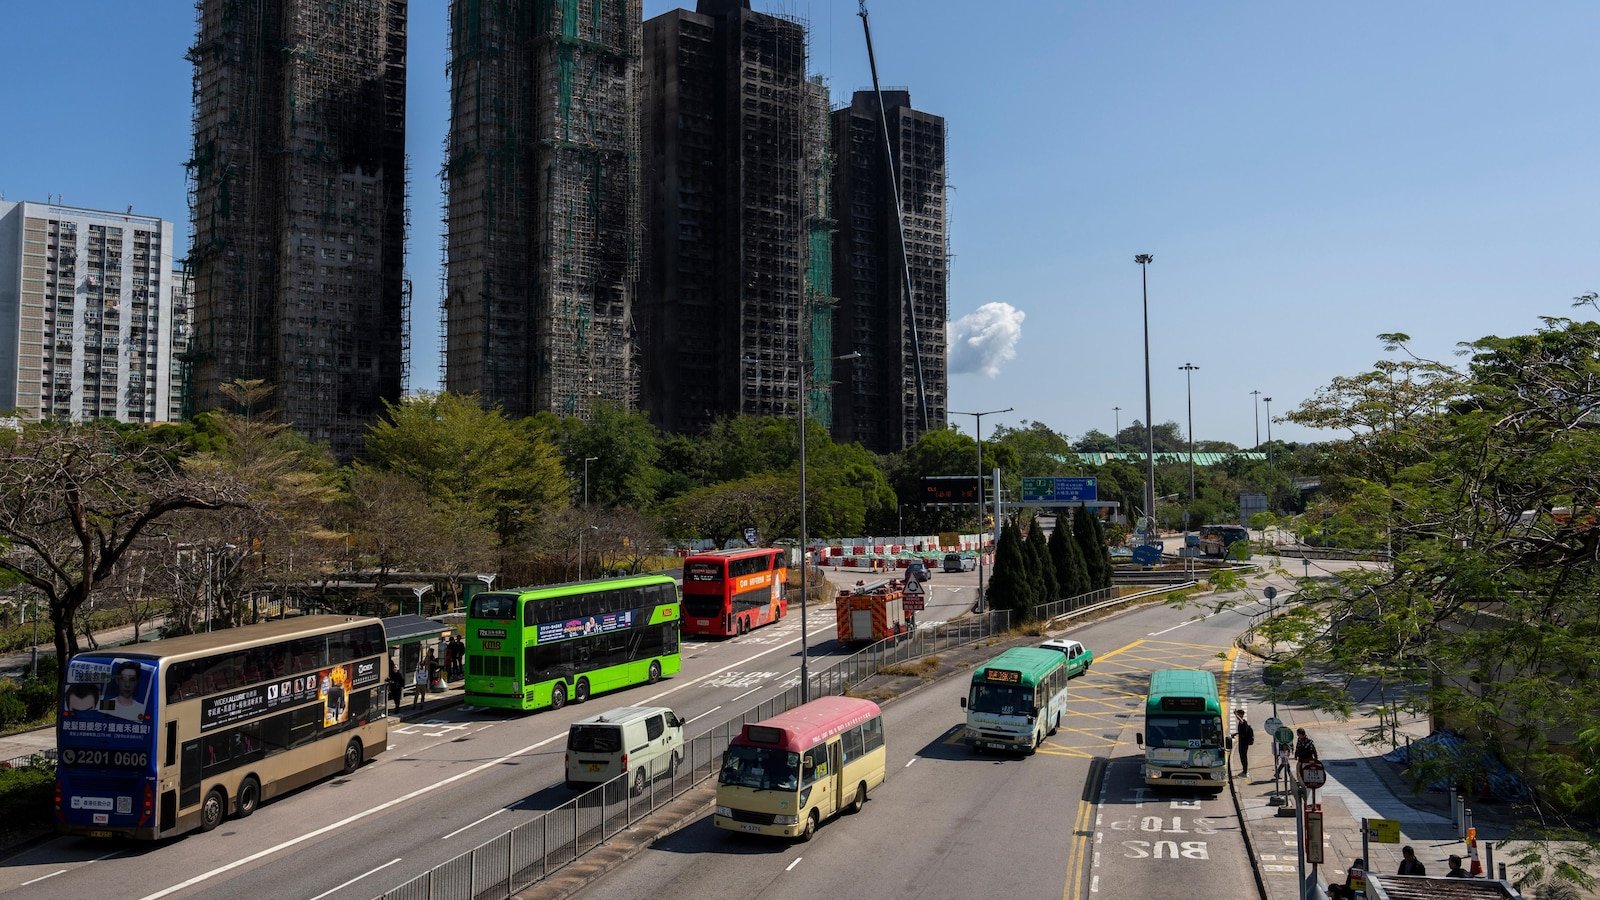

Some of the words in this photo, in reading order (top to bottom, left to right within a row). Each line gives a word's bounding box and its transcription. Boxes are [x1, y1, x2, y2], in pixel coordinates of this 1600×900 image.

[78, 750, 109, 765] 2201
[114, 752, 148, 767] 0606
[1111, 815, 1218, 835] STOP
[1122, 840, 1210, 860] BUS
